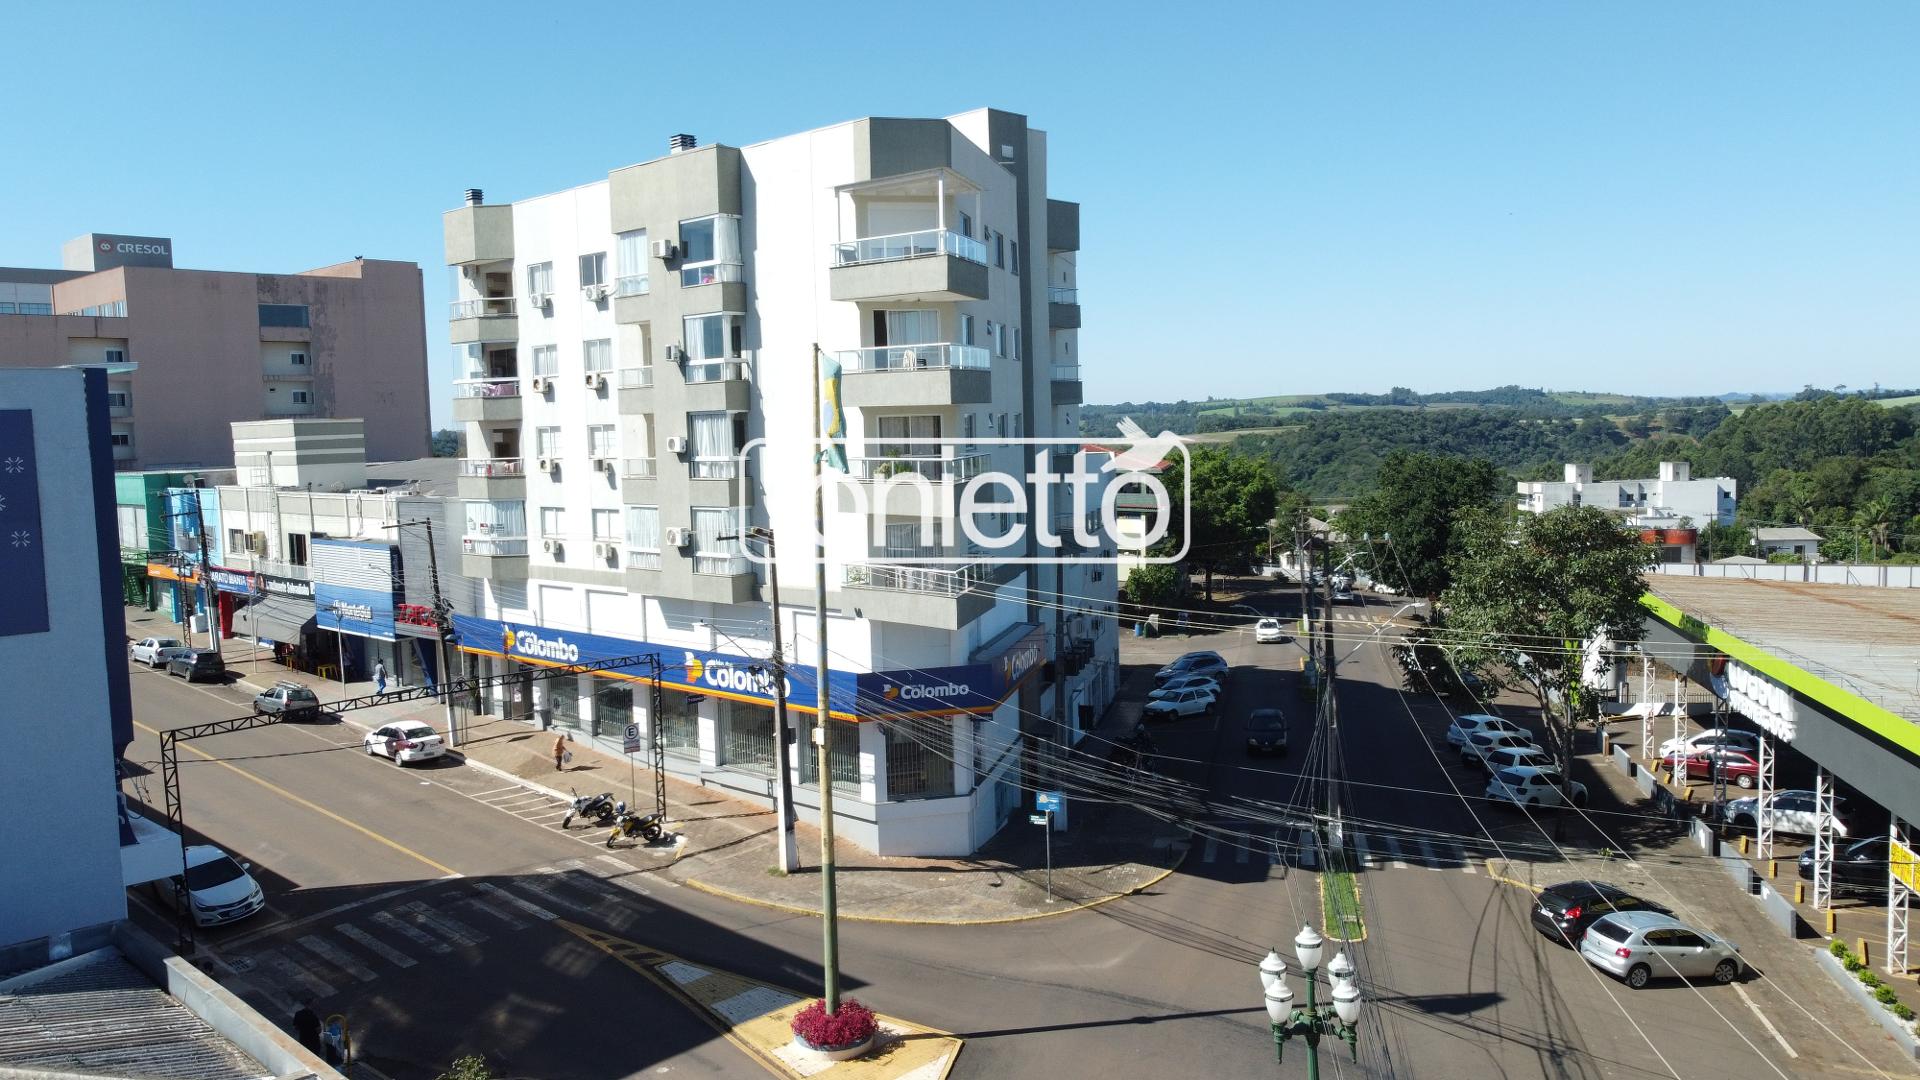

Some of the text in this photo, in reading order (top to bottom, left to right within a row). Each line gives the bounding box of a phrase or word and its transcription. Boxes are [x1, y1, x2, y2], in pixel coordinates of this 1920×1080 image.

[117, 243, 169, 255] CRESOL
[516, 630, 579, 662] Colombo
[900, 683, 969, 700] Colombo
[628, 727, 635, 737] E
